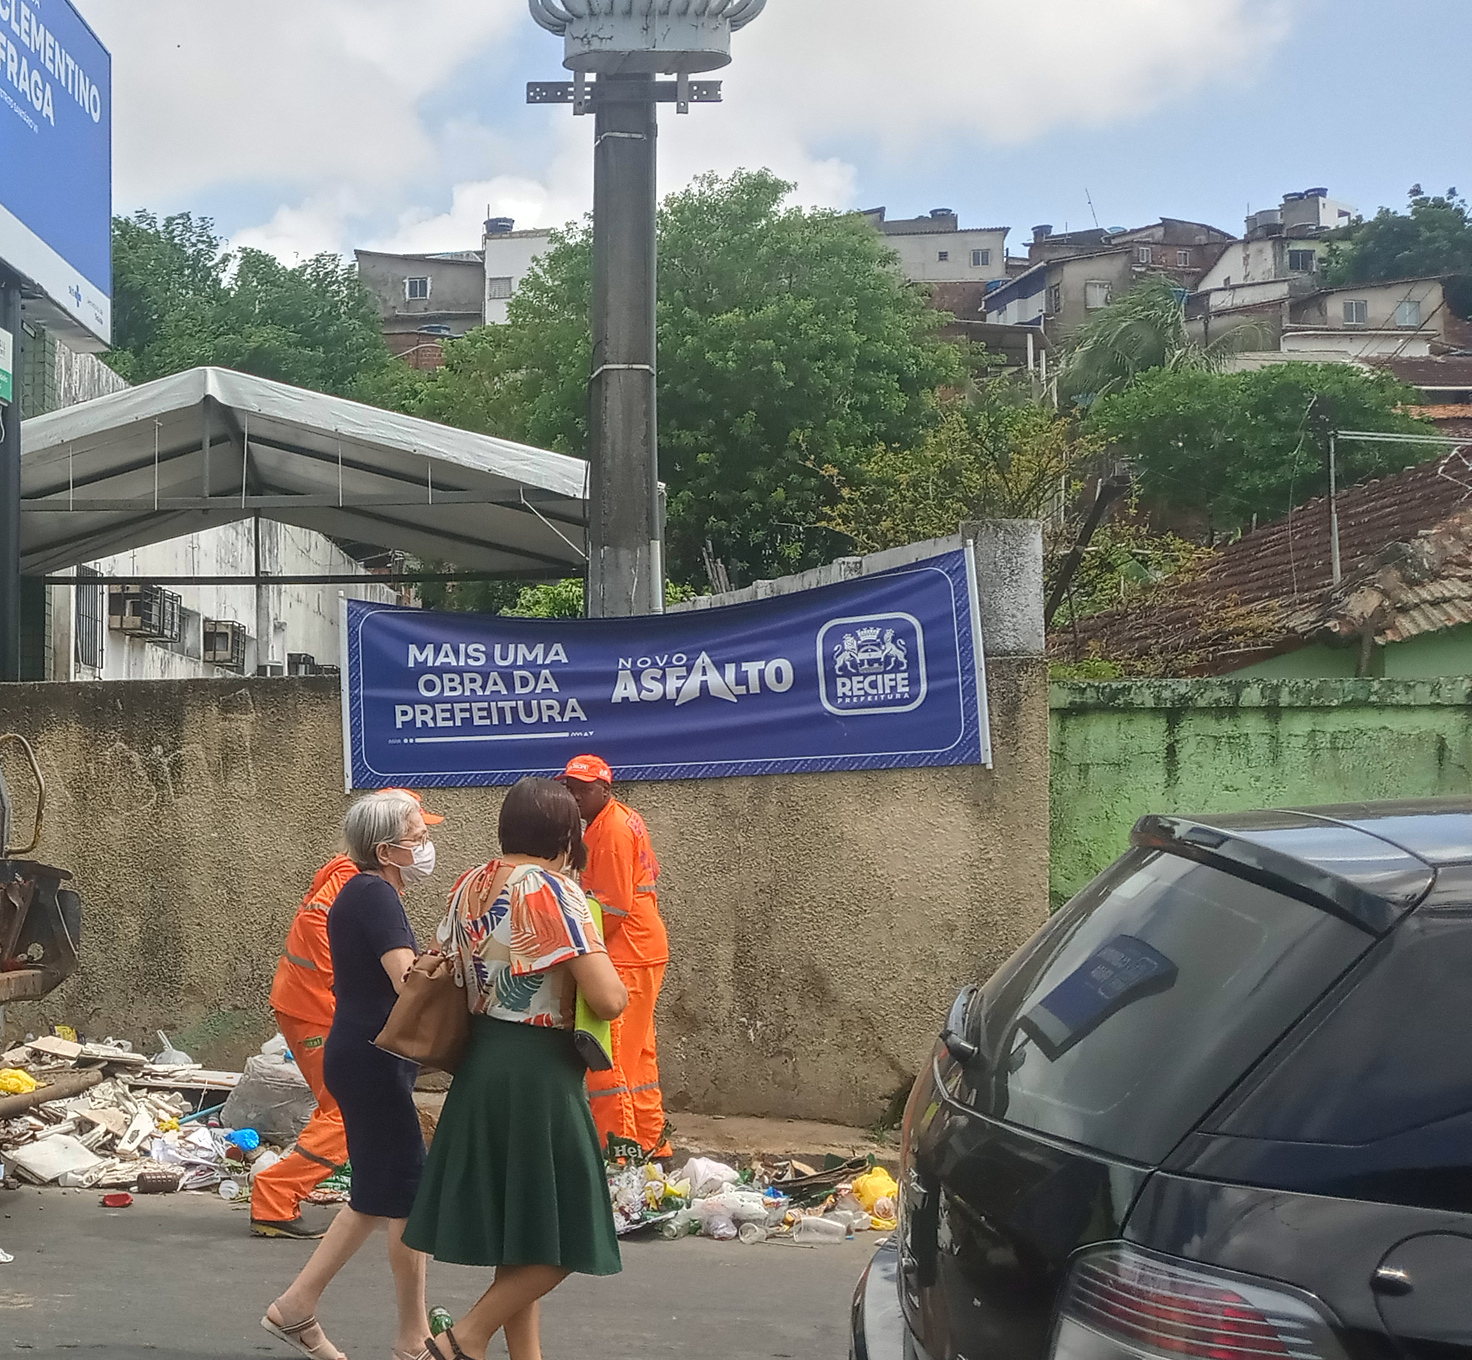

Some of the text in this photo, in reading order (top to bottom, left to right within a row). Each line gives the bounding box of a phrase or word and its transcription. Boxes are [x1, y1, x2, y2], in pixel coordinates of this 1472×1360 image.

[408, 643, 569, 667] MAIS UMA
[618, 653, 687, 669] NOVO
[418, 669, 559, 697] OBRA DA
[611, 651, 794, 706] ASFALTO
[836, 673, 910, 697] RECIFE
[837, 693, 910, 704] PREFEITURA
[395, 698, 588, 729] PREFEITURA
[613, 1144, 644, 1159] Hei
